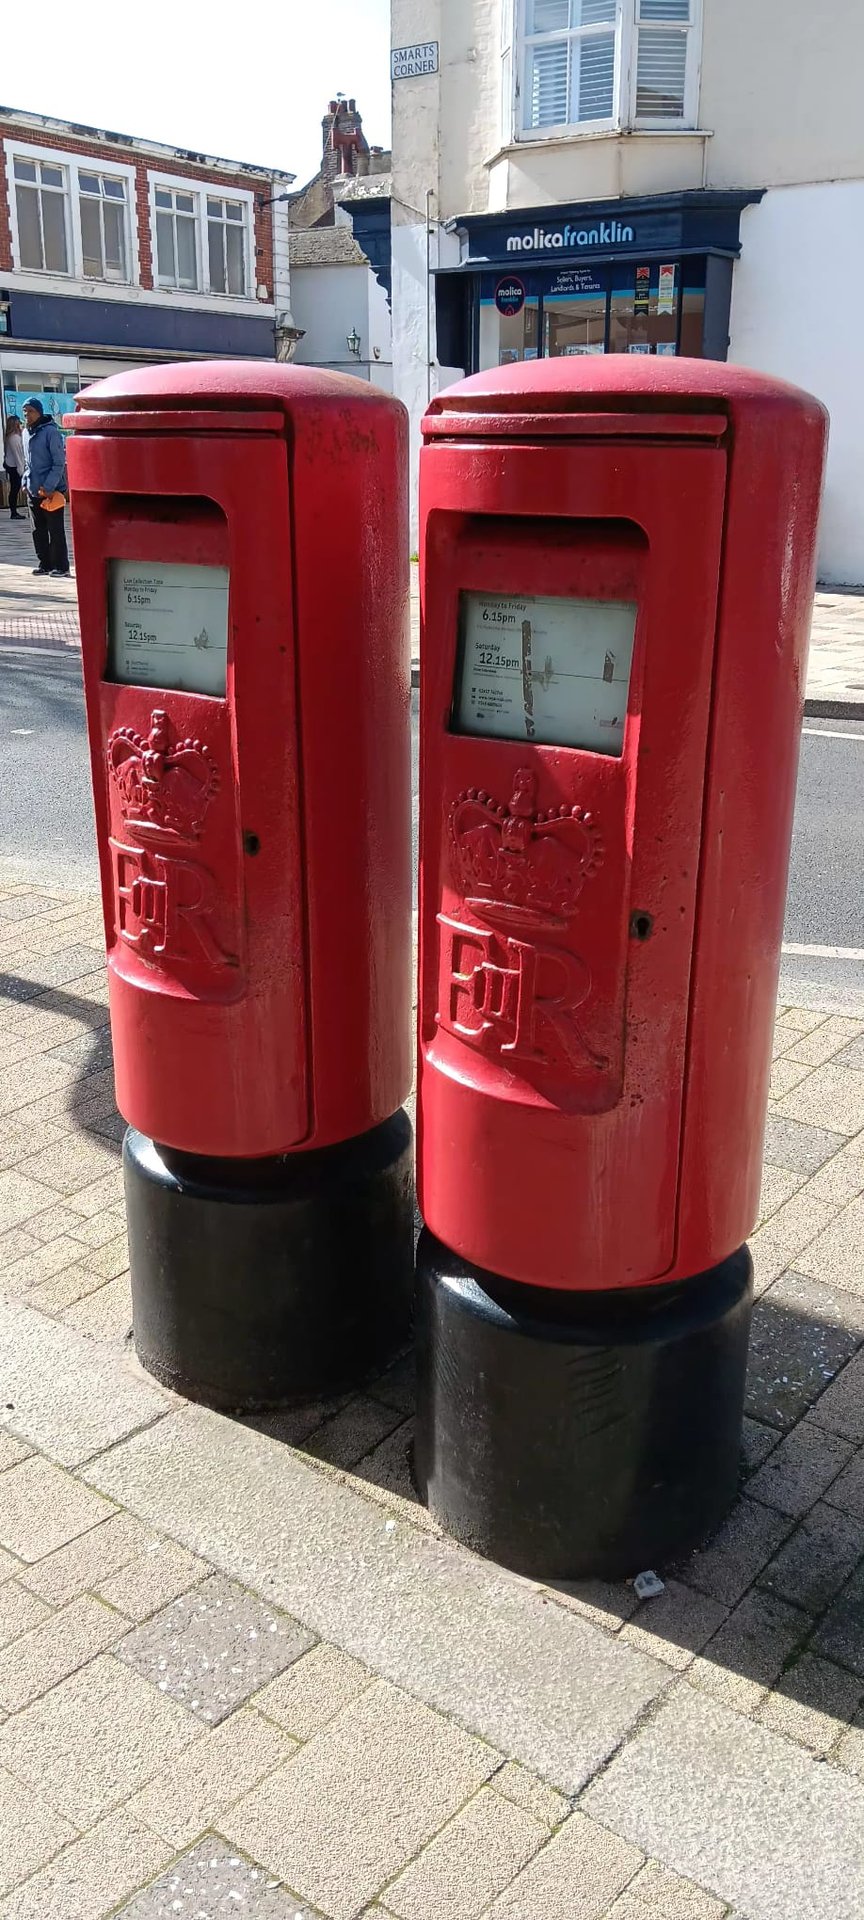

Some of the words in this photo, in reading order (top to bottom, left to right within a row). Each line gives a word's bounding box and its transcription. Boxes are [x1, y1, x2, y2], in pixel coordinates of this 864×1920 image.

[394, 45, 434, 63] SMARTS
[394, 60, 435, 76] CORNER
[506, 221, 633, 251] molicafranklin
[498, 286, 522, 296] molica
[127, 593, 151, 605] 6.15pm
[508, 602, 526, 611] Friday
[482, 608, 516, 624] 6.15pm
[128, 630, 157, 643] 12.15pm
[475, 642, 500, 652] Saturday
[479, 652, 520, 669] 12.15pm
